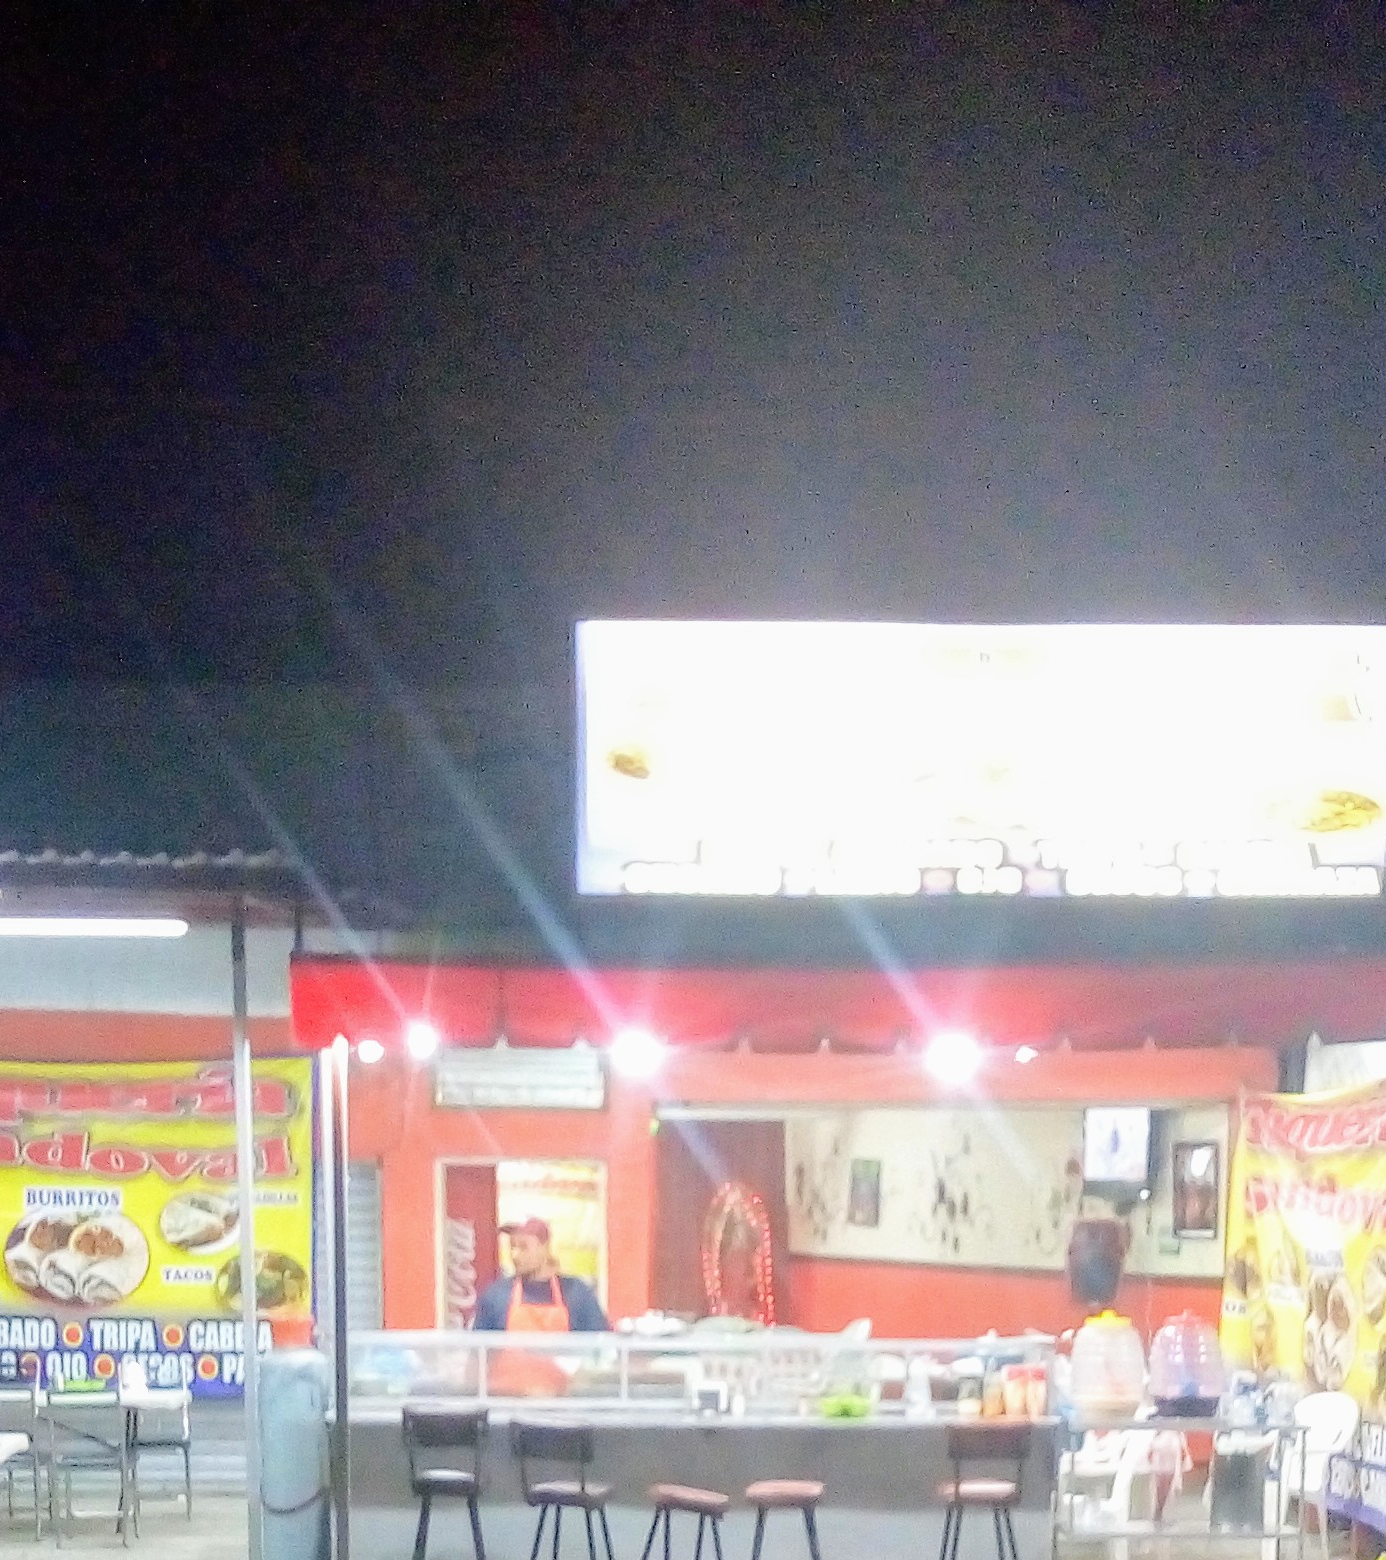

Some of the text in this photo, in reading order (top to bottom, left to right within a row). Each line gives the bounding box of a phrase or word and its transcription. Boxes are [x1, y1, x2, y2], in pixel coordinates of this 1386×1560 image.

[26, 1189, 120, 1207] BURRITOS
[164, 1268, 213, 1282] TACOS
[89, 1318, 157, 1351] TRIPA
[188, 1319, 273, 1352] CABEA
